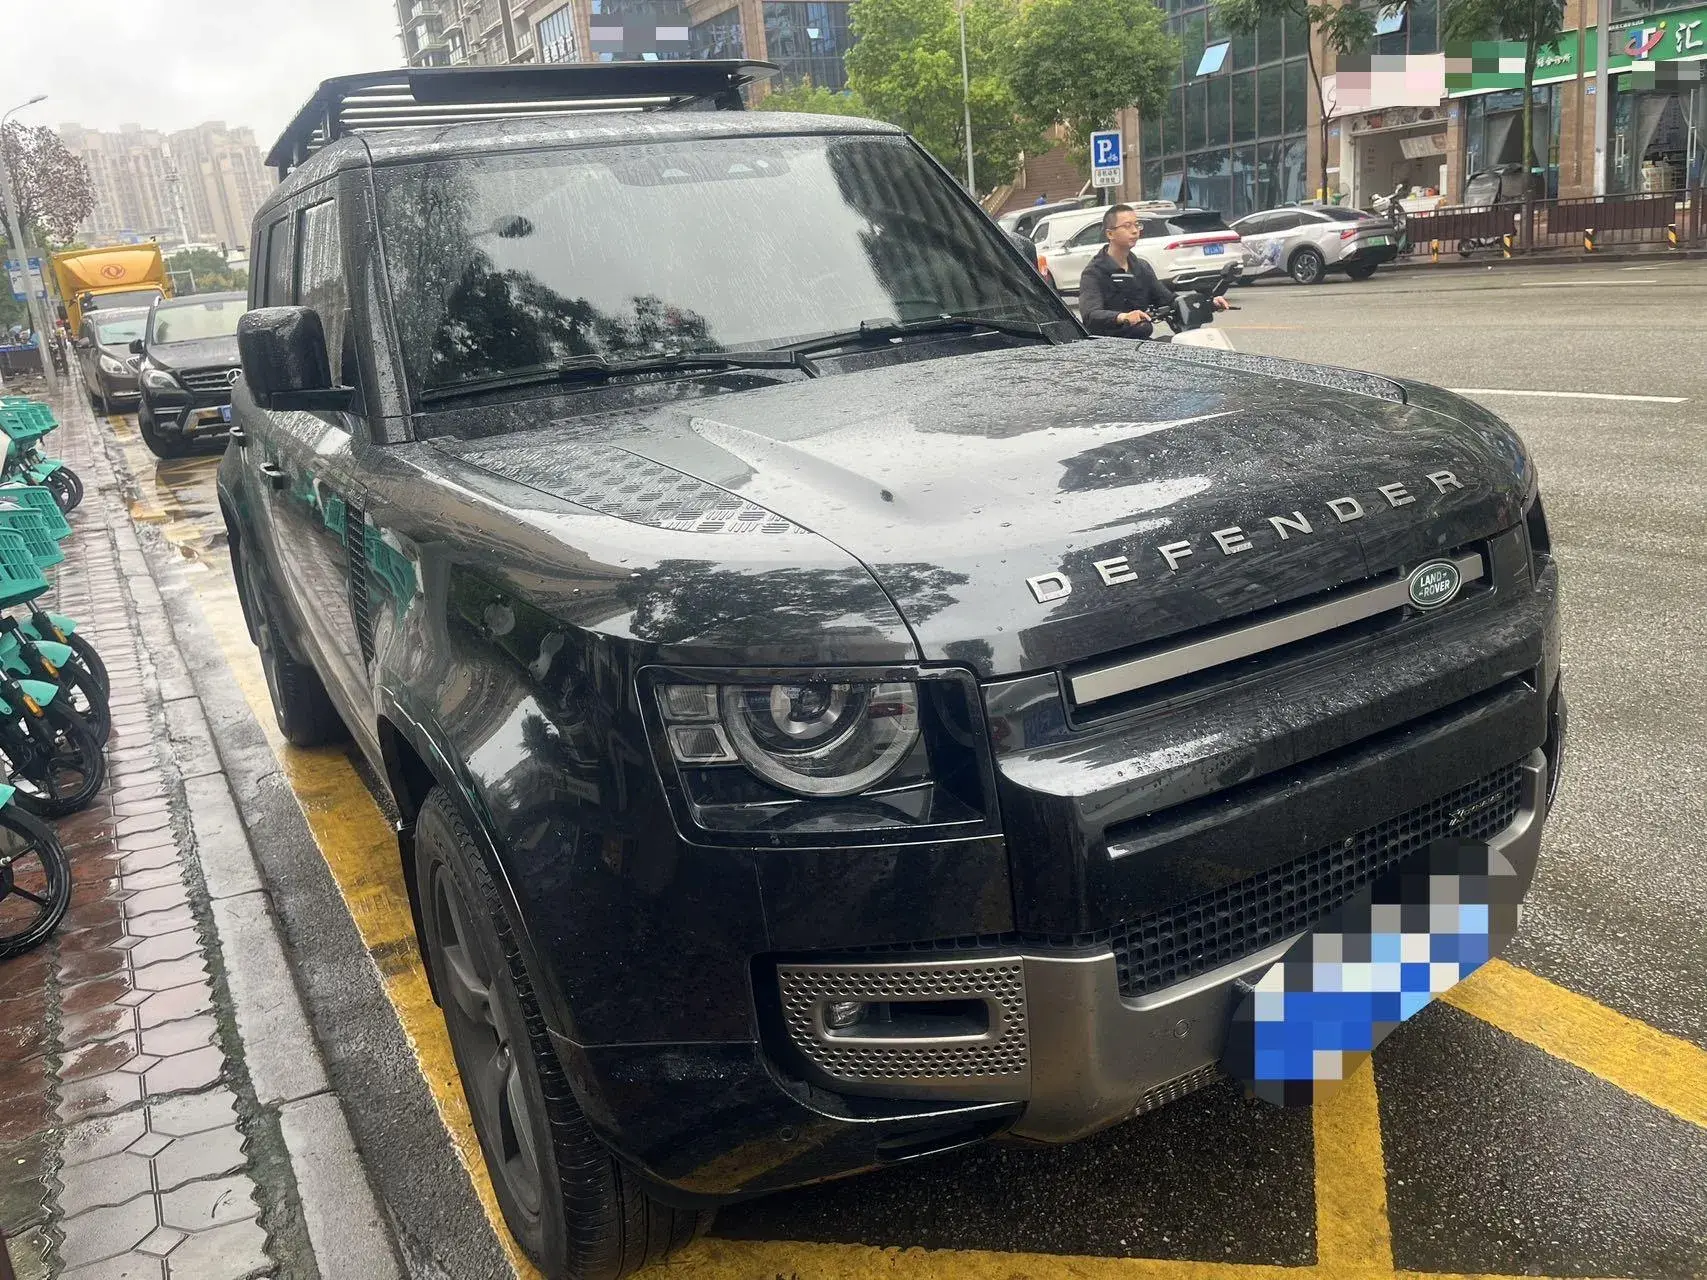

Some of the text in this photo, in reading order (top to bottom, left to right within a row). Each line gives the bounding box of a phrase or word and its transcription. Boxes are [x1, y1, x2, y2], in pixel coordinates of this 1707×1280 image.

[1675, 20, 1704, 53] 汇
[1097, 139, 1112, 163] P
[1025, 470, 1465, 604] DEFENDER
